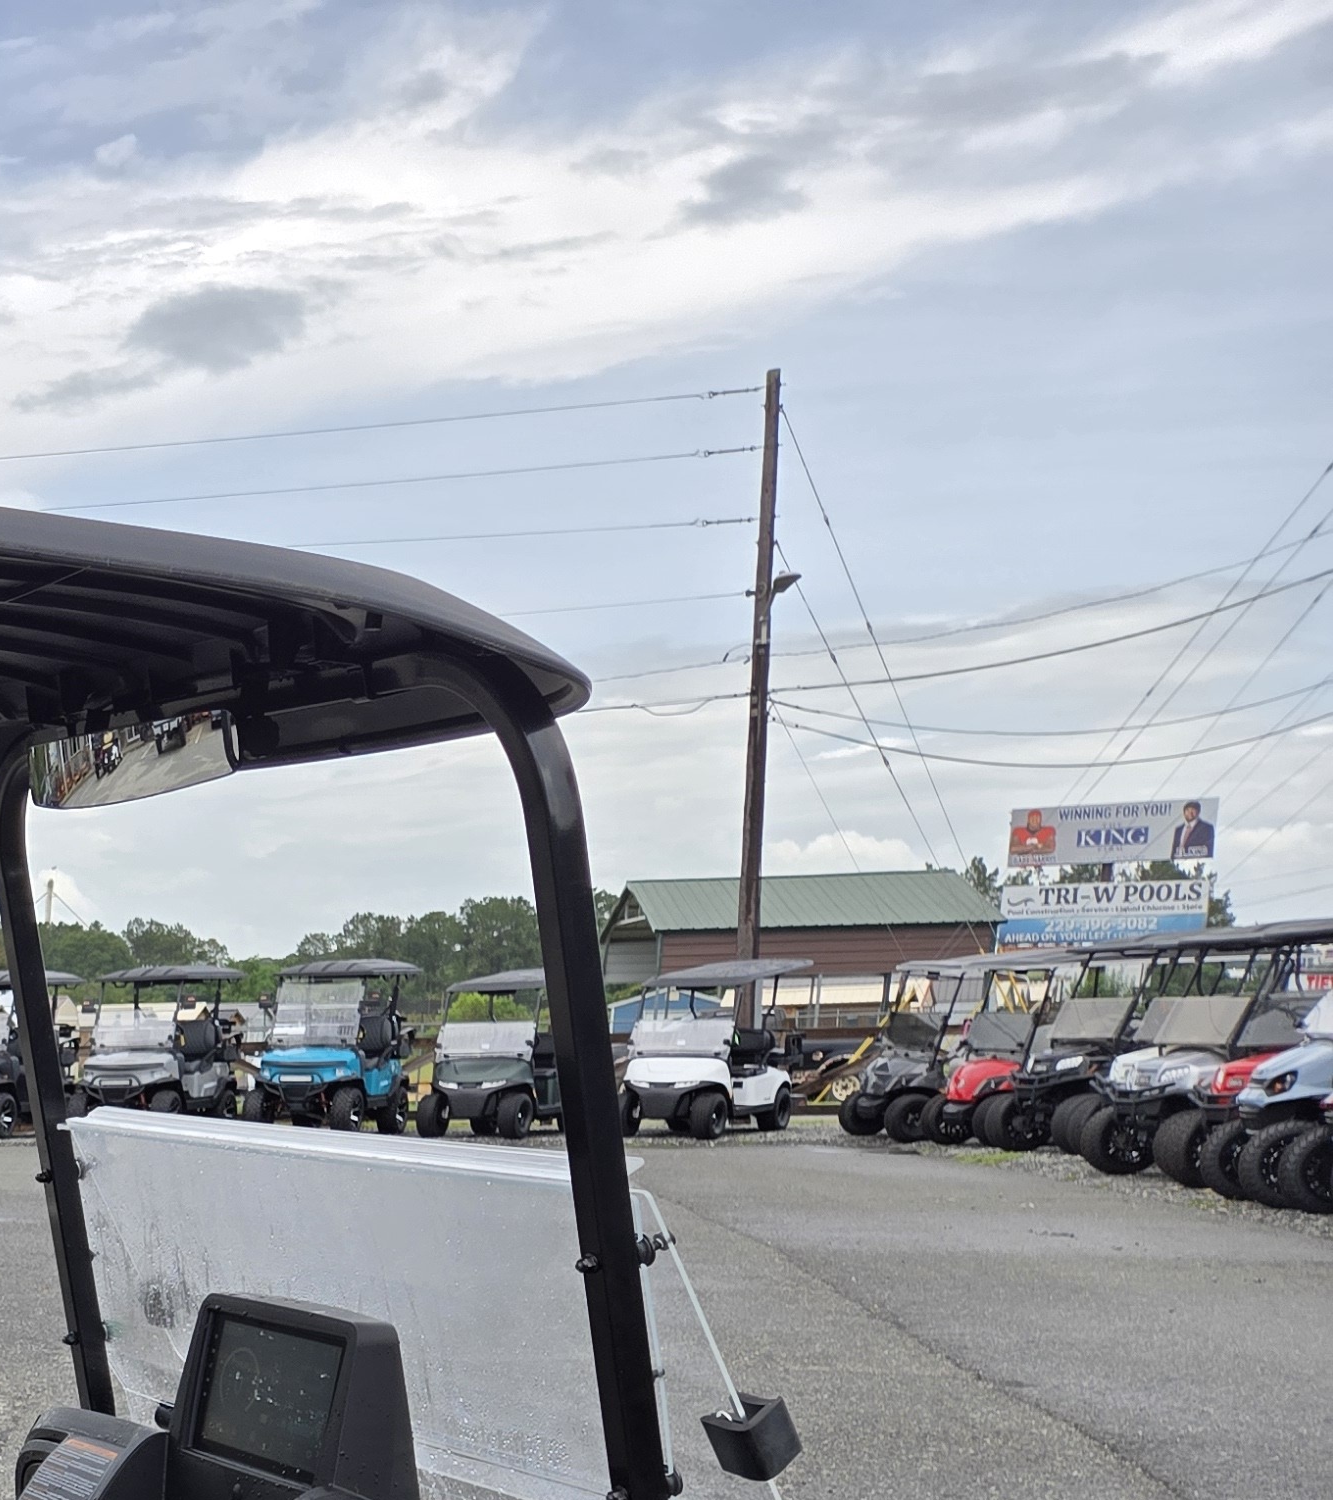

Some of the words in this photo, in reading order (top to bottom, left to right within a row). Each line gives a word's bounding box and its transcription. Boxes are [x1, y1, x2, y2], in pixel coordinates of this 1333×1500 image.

[1058, 806, 1111, 821] WINNING
[1115, 804, 1139, 818] FOR
[1144, 802, 1172, 817] YOU!
[1080, 827, 1145, 847] KING
[1039, 885, 1118, 905] TRI-W
[1124, 882, 1202, 903] POOLS
[1005, 932, 1039, 943] AHEAD
[1041, 932, 1056, 941] ON
[1060, 931, 1087, 941] YOUR
[1089, 930, 1111, 940] LEFT
